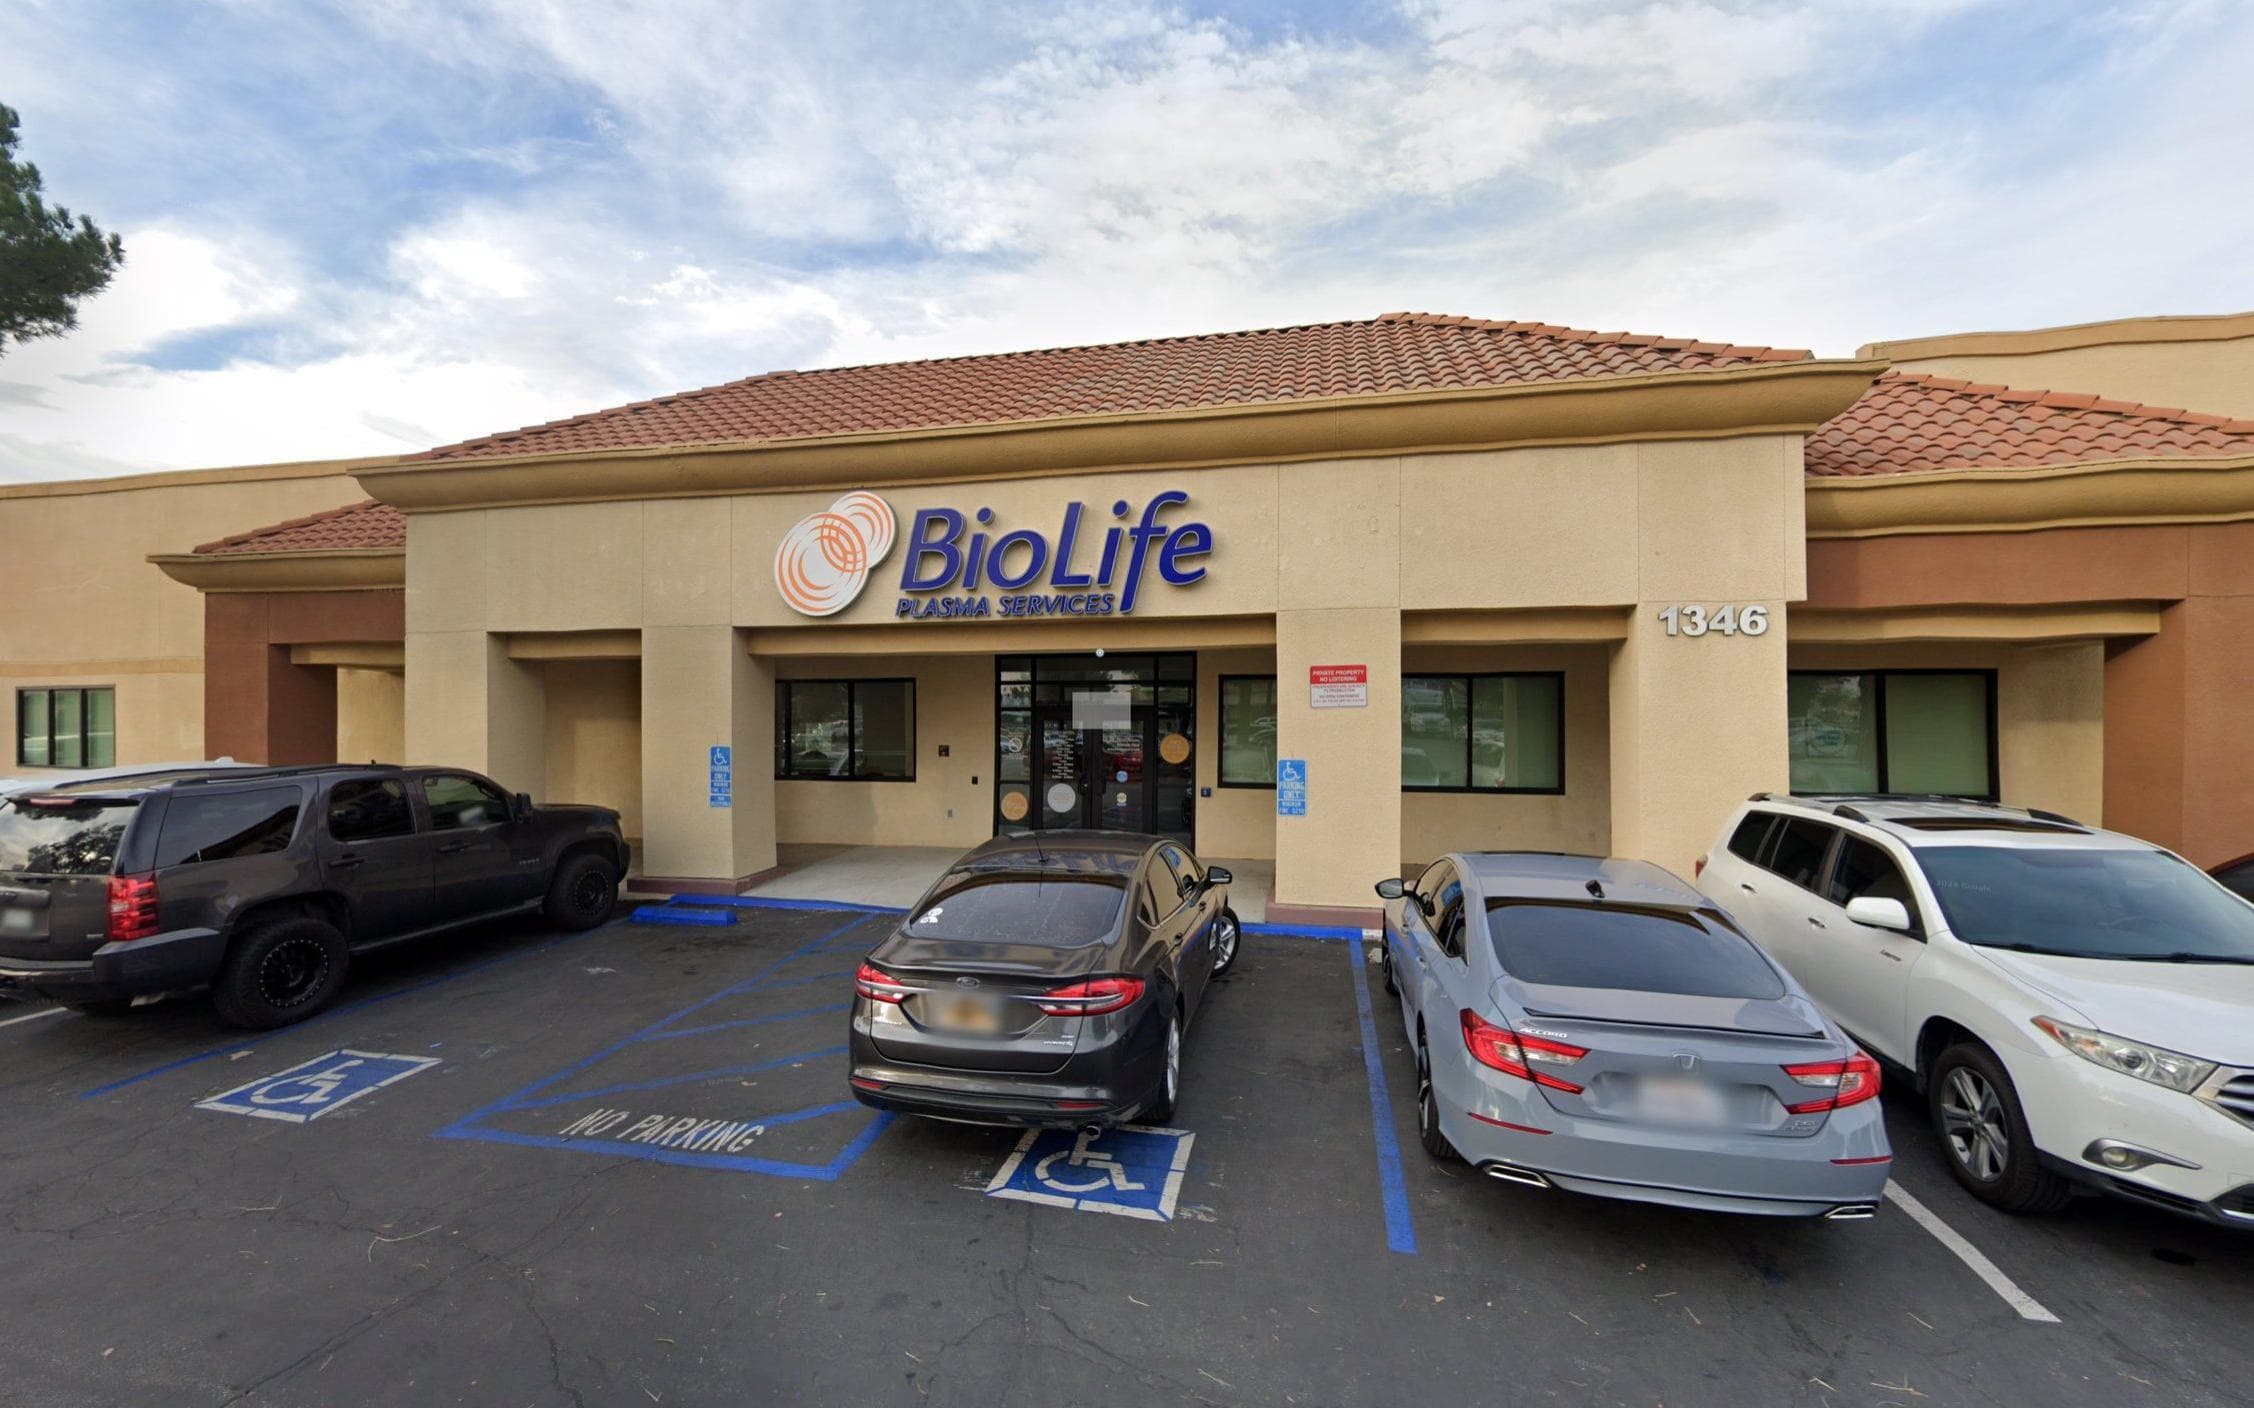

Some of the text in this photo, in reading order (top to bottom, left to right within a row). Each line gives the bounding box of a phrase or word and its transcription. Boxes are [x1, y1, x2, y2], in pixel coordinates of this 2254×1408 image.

[899, 489, 1214, 615] BioLife
[895, 593, 1115, 618] PLASMA SERVICES
[1658, 604, 1768, 637] 1346
[1279, 781, 1305, 790] PARKING
[1283, 790, 1301, 800] ONLY
[1519, 1027, 1568, 1038] ACCORD
[558, 1108, 765, 1153] NO PARKING
